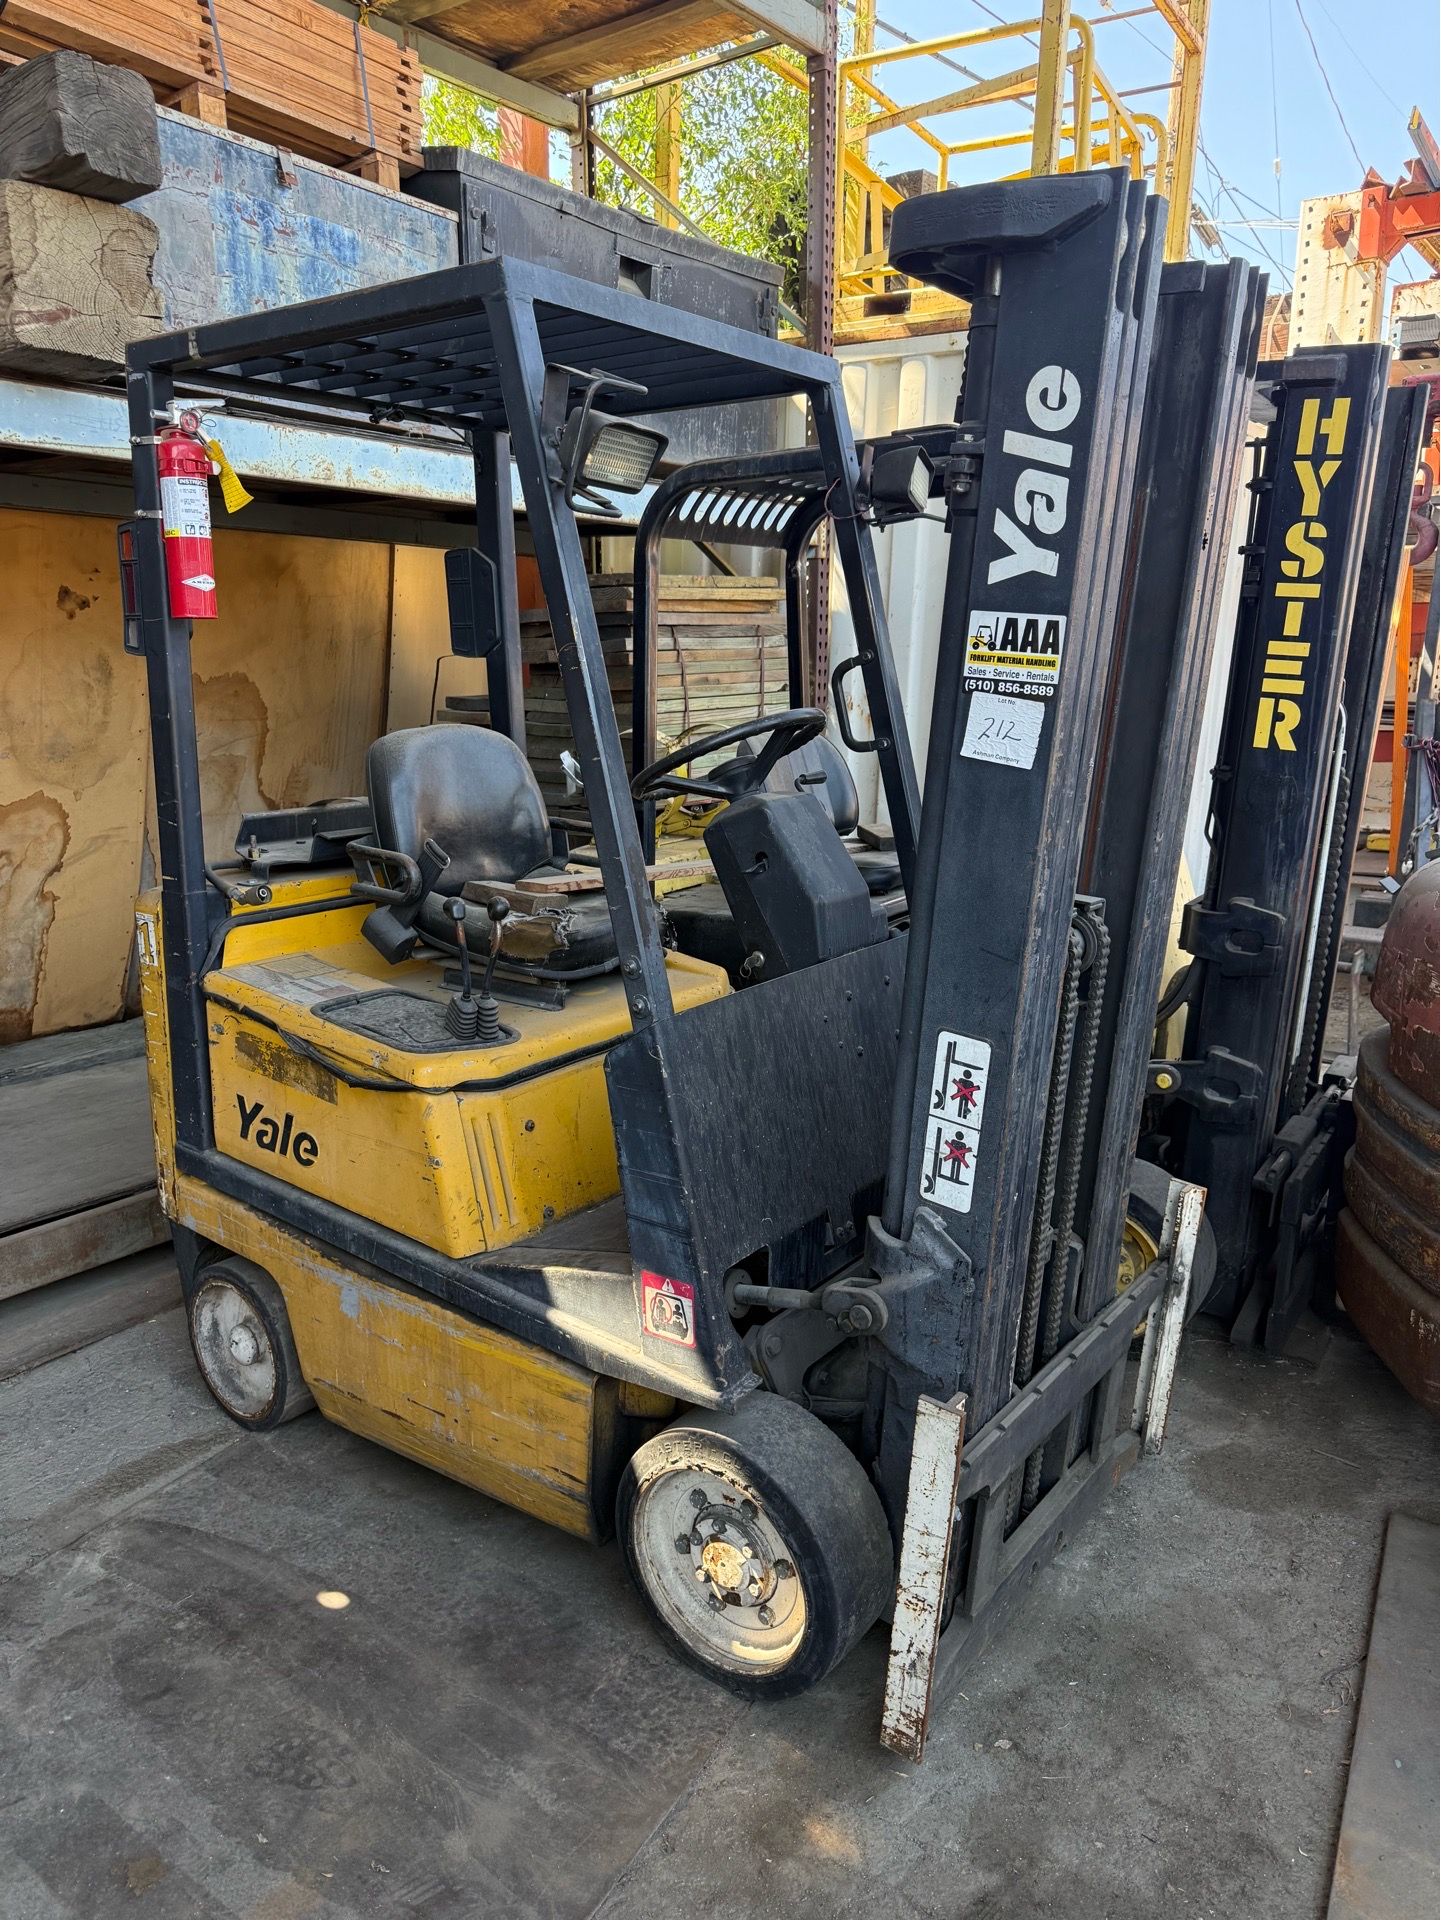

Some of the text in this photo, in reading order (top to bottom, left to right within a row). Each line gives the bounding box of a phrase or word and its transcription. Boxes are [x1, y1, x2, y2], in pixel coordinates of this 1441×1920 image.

[987, 365, 1082, 585] Yale
[1252, 397, 1351, 752] HYSTER
[1000, 617, 1060, 655] AAA
[969, 653, 1057, 668] FORKLIFT MATERIAL HANDLING
[967, 666, 1055, 682] Sales Service Rentals
[965, 679, 1054, 697] (510) 856-8589
[1007, 698, 1016, 706] No.
[977, 717, 1022, 742] 212
[972, 749, 1020, 765] Ashman Company
[236, 1093, 319, 1167] Yale
